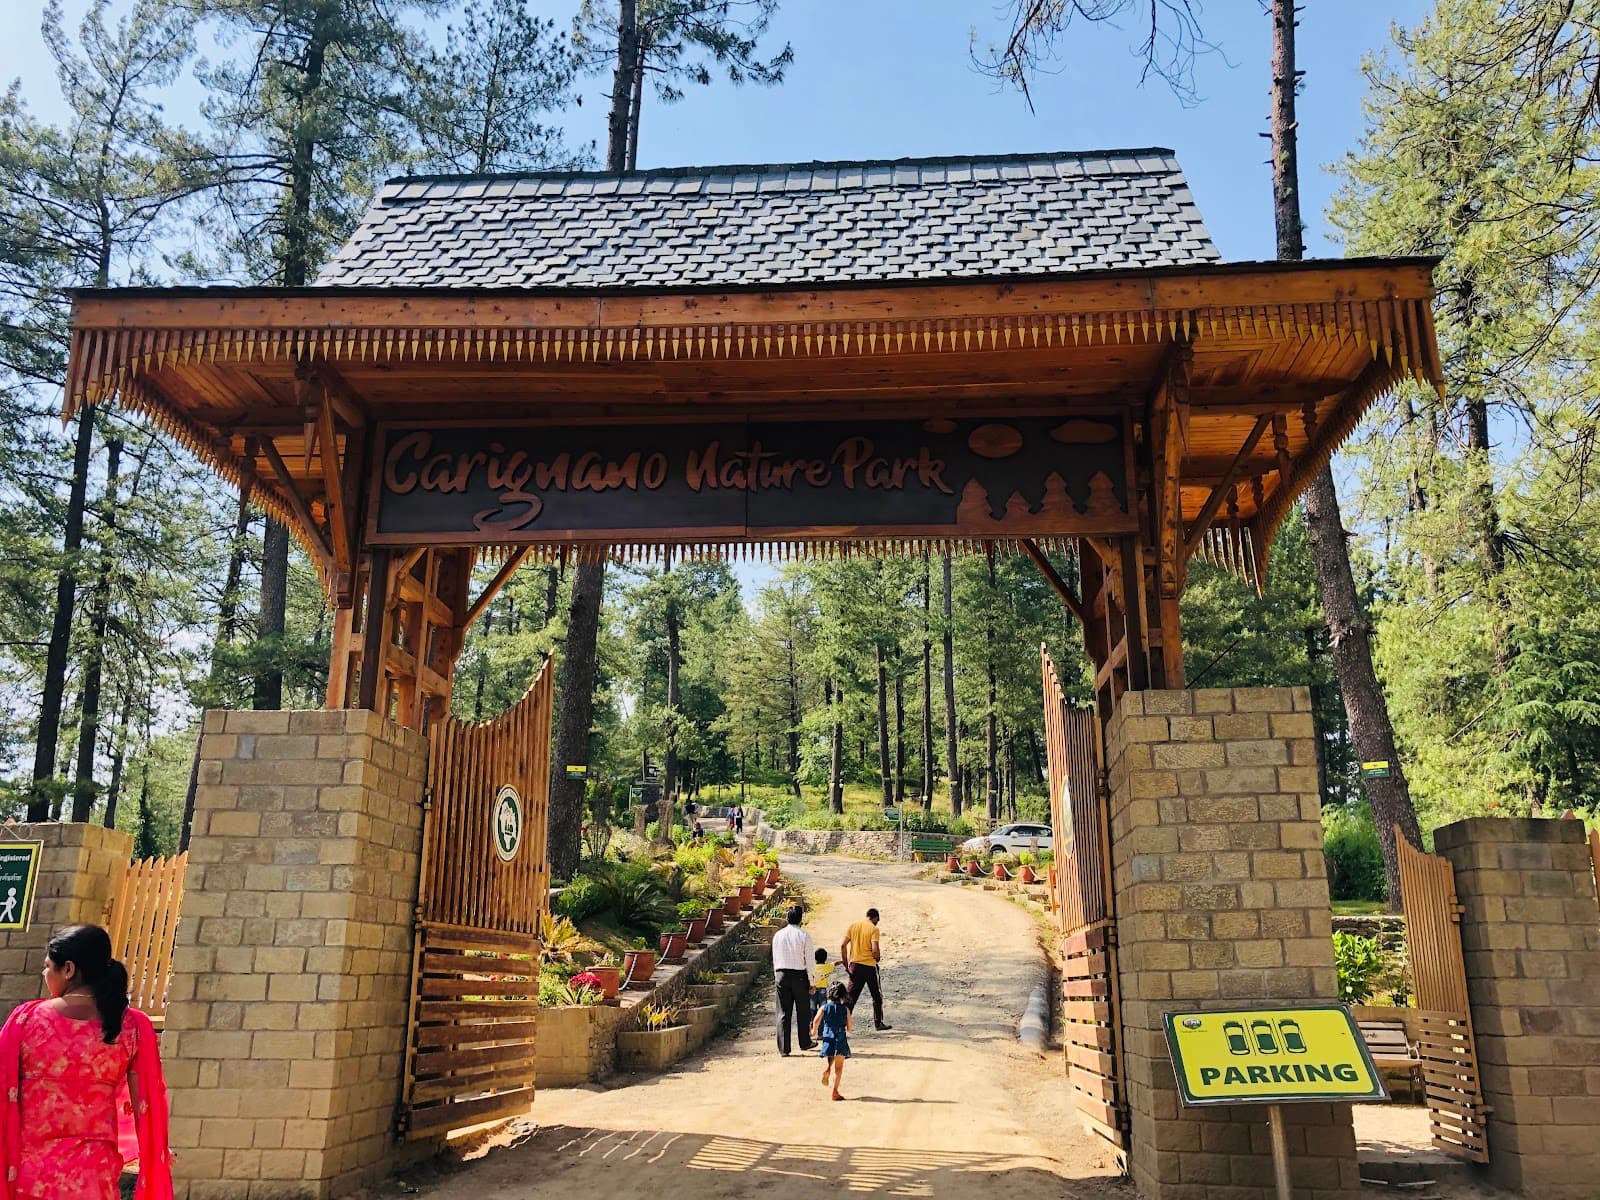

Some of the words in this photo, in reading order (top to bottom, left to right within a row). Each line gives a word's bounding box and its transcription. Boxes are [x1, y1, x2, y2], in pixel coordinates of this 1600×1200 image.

[384, 431, 668, 532] Carignano
[686, 440, 832, 491] Nature
[832, 437, 953, 494] Park
[0, 854, 31, 862] egistered
[1201, 1064, 1358, 1085] PARKING
